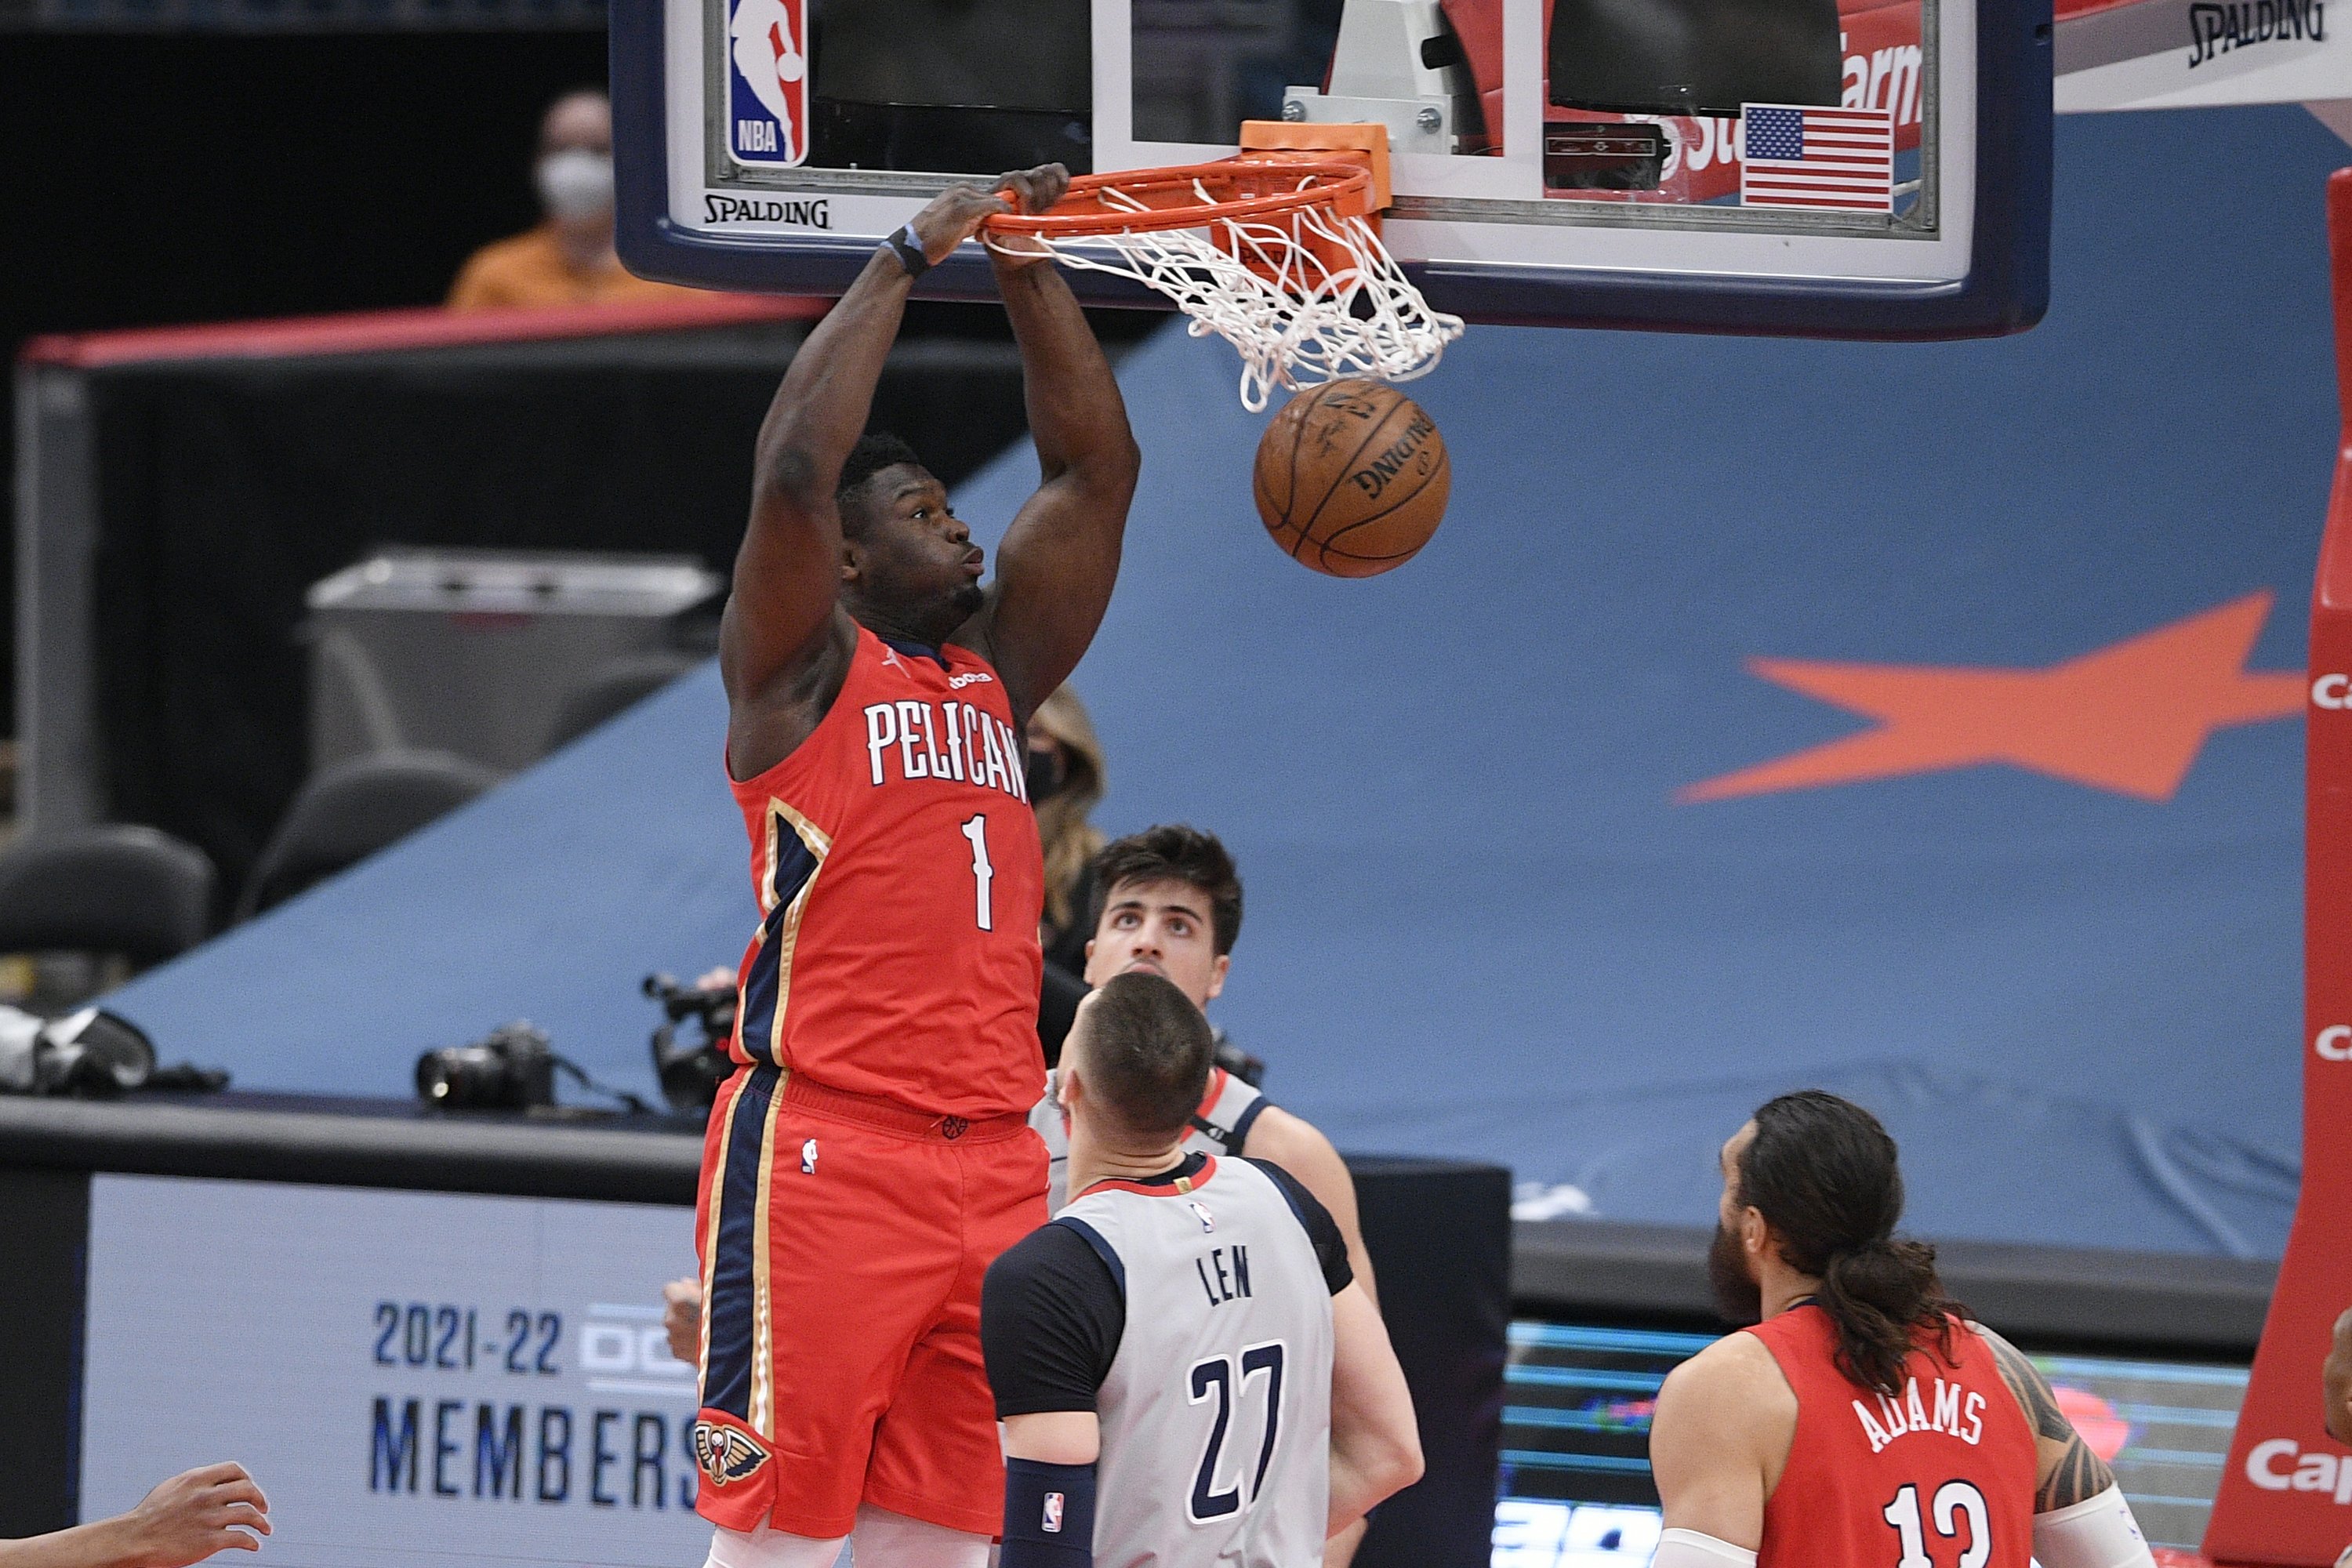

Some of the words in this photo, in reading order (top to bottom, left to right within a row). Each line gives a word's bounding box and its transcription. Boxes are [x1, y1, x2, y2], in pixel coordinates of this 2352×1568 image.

[2189, 0, 2325, 69] SPALDING
[1840, 31, 1922, 125] arm
[738, 119, 778, 154] NBA
[705, 193, 829, 230] SPALDING
[960, 812, 994, 932] 1
[1196, 1244, 1252, 1306] LEN
[375, 1301, 561, 1375] 2021-22
[1185, 1338, 1287, 1526] 27
[1851, 1376, 1987, 1454] ADAMS
